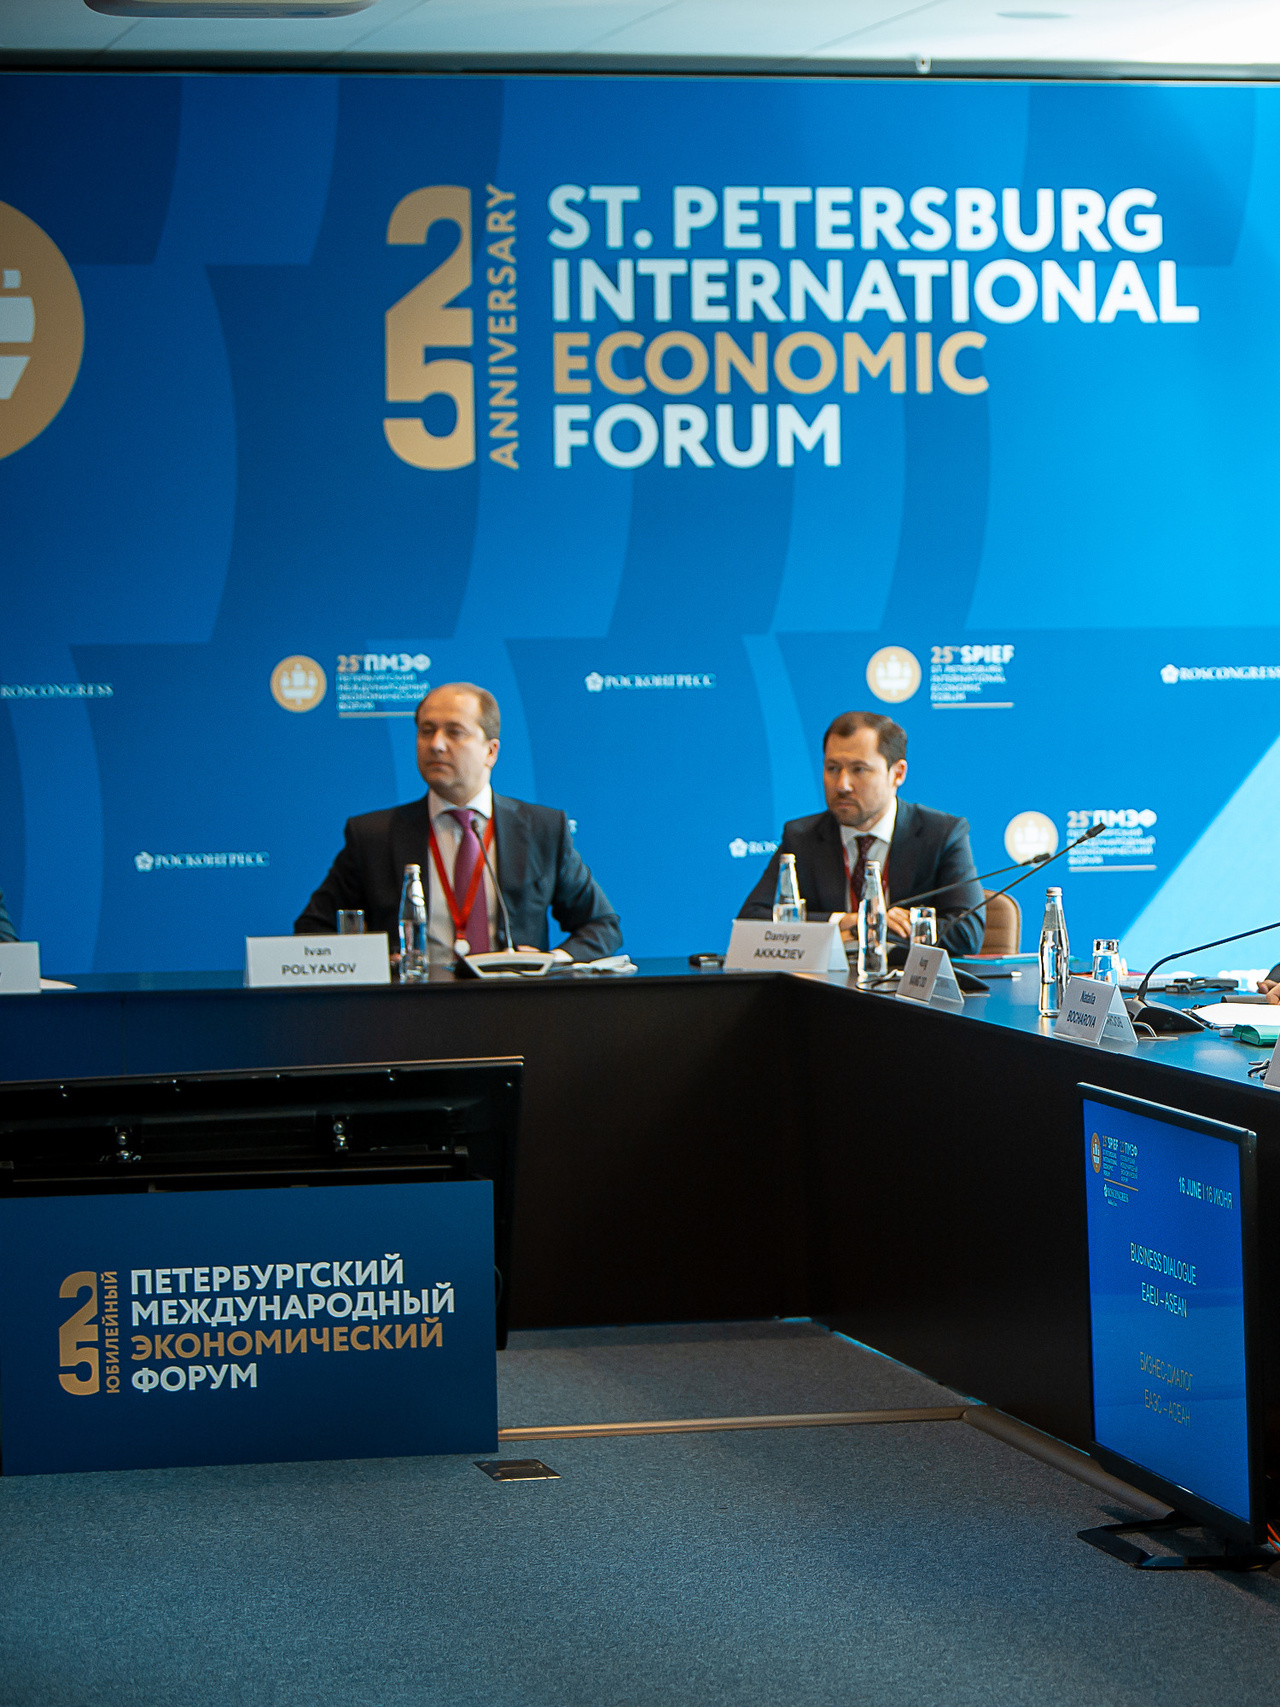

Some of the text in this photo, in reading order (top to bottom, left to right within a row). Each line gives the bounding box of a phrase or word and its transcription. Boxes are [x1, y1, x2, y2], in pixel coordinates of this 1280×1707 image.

[547, 185, 1164, 253] ST. PETERSBURG
[552, 257, 1200, 324] INTERNATIONAL
[485, 183, 519, 471] ANNIVERSARY
[552, 330, 990, 395] ECONOMIC
[552, 402, 842, 468] FORUM
[363, 653, 432, 673] ПМЭФ
[960, 645, 1015, 664] SPIEF
[1092, 809, 1157, 828] ПМЭФ
[304, 945, 332, 957] Ivan
[754, 948, 806, 960] AKKAZIEV
[764, 930, 801, 944] Daniyar
[281, 962, 357, 976] POLYAKOV
[1066, 1009, 1098, 1029] BOCHAROVA
[1178, 1176, 1186, 1194] 16
[1186, 1178, 1202, 1200] JUNE
[1206, 1185, 1214, 1203] 16
[1213, 1187, 1233, 1210] ИЮНЯ
[130, 1253, 404, 1295] ПЕТЕРБУРГСКИЙ
[1130, 1241, 1197, 1286] BUSINESS DIALOGUE
[131, 1282, 455, 1327] МЕЖДУНАРОДНЫЙ
[1141, 1281, 1159, 1307] EAEU
[1165, 1291, 1187, 1319] ASEAN
[101, 1271, 121, 1394] ЮБИЛЕЙНЫЙ
[130, 1317, 443, 1360] ЭКОНОМИЧЕСКИЙ
[131, 1363, 257, 1392] ФОРУМ
[1168, 1400, 1191, 1428] АСЕАН
